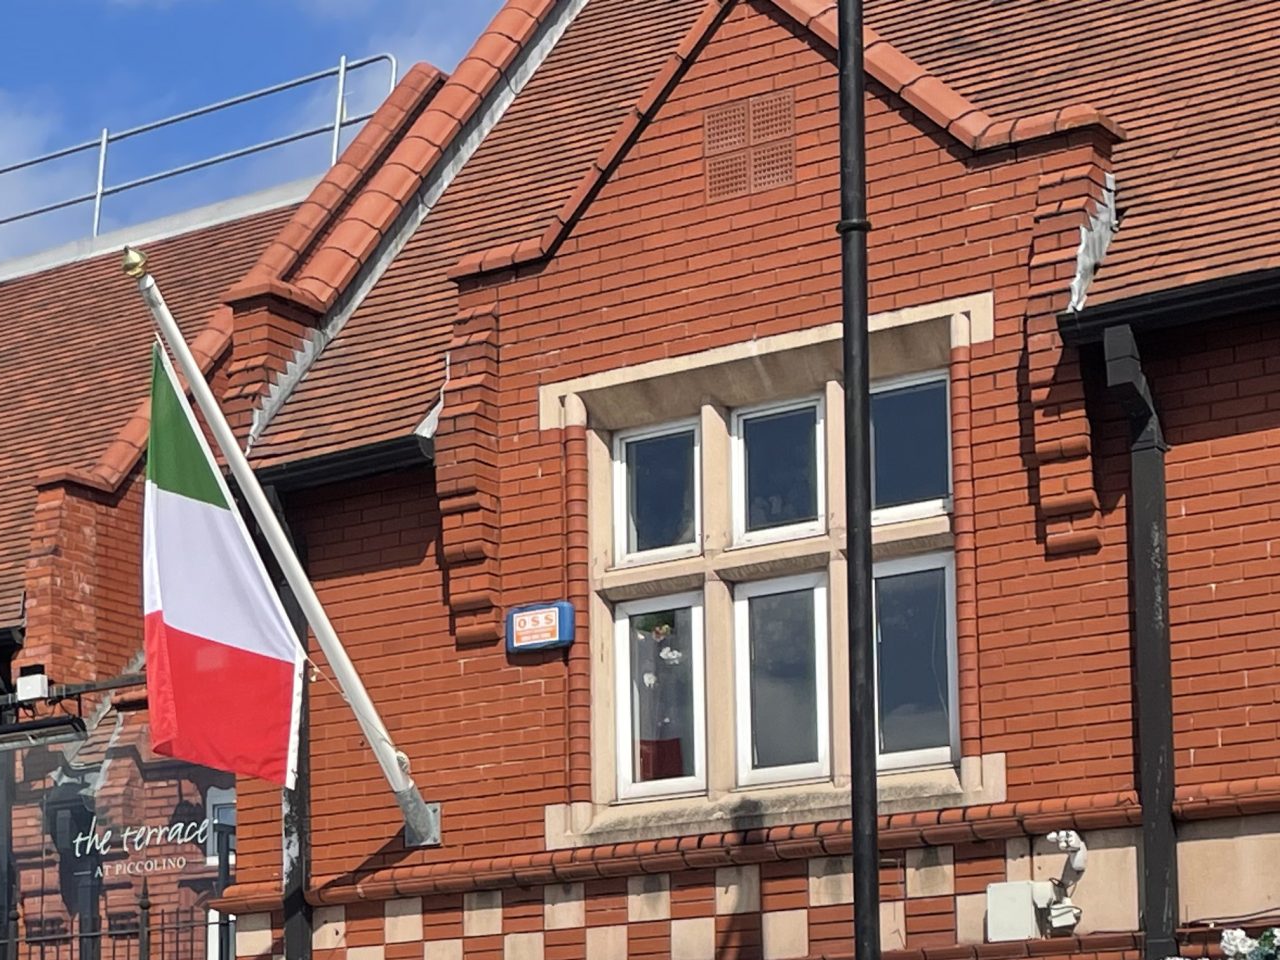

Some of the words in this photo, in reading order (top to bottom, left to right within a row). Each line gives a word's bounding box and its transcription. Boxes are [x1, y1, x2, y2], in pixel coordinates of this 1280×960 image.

[72, 815, 113, 857] the
[120, 818, 210, 852] terrace
[94, 864, 113, 878] AT
[115, 856, 187, 875] PICCOLINO
